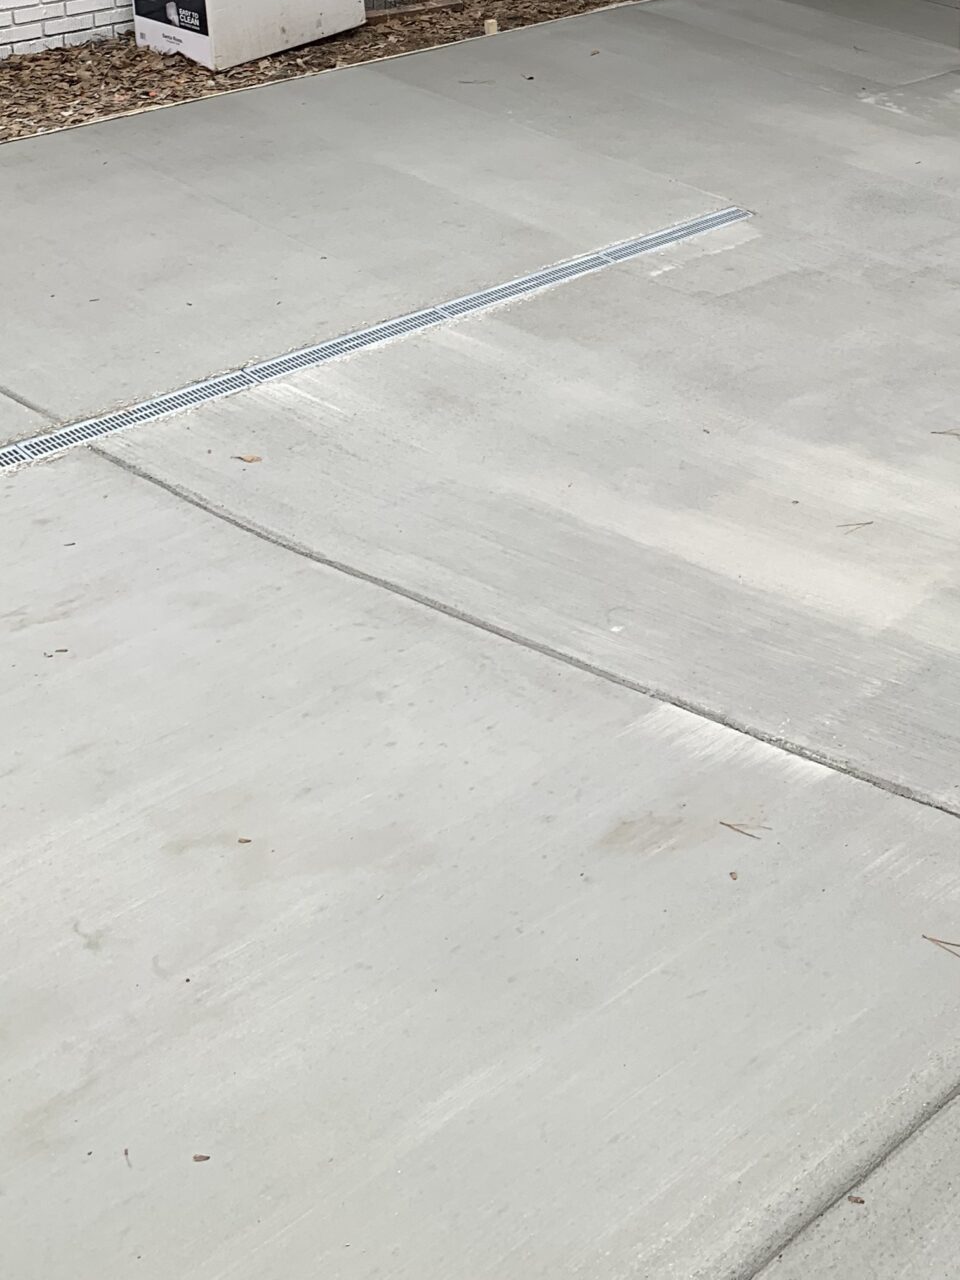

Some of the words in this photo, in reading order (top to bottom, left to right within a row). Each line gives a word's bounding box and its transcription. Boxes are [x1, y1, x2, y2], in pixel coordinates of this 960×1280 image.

[179, 8, 192, 17] EASY
[191, 11, 199, 19] TO
[179, 14, 200, 26] CLEAN
